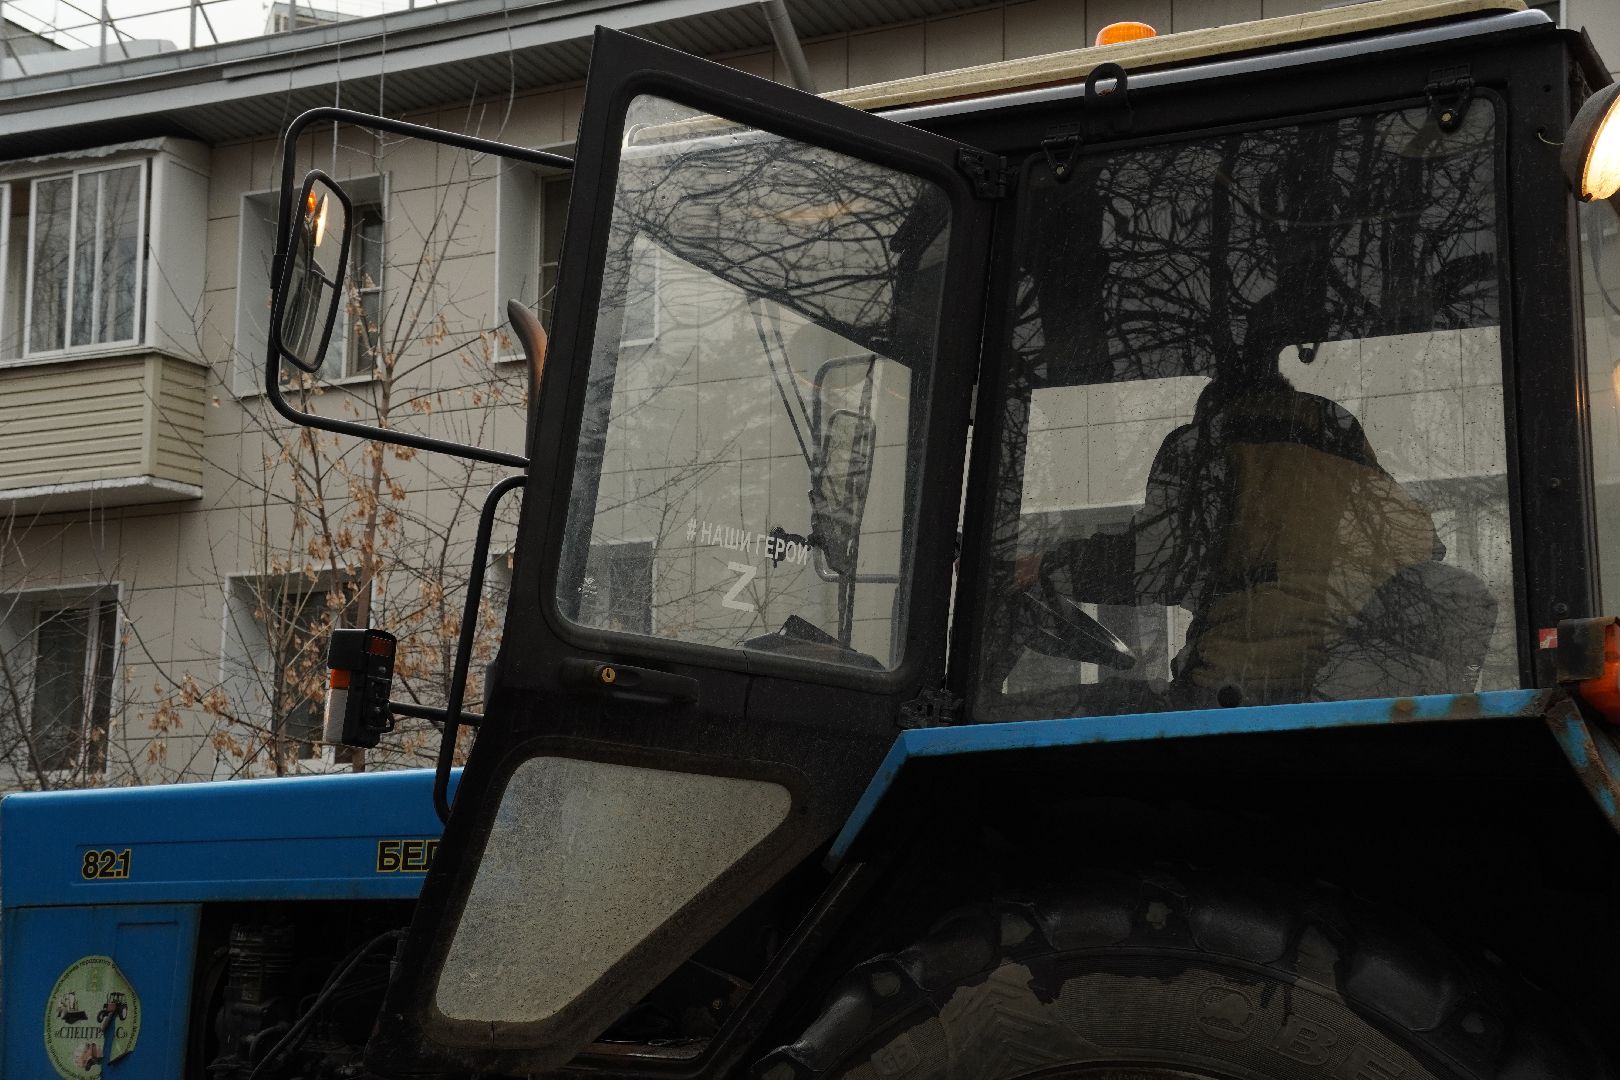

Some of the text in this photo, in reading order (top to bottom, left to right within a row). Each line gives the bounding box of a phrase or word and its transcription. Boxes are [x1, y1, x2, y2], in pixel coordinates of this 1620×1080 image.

[756, 532, 809, 566] ГЕРОИ
[721, 561, 757, 613] Z
[81, 848, 132, 880] 82.1
